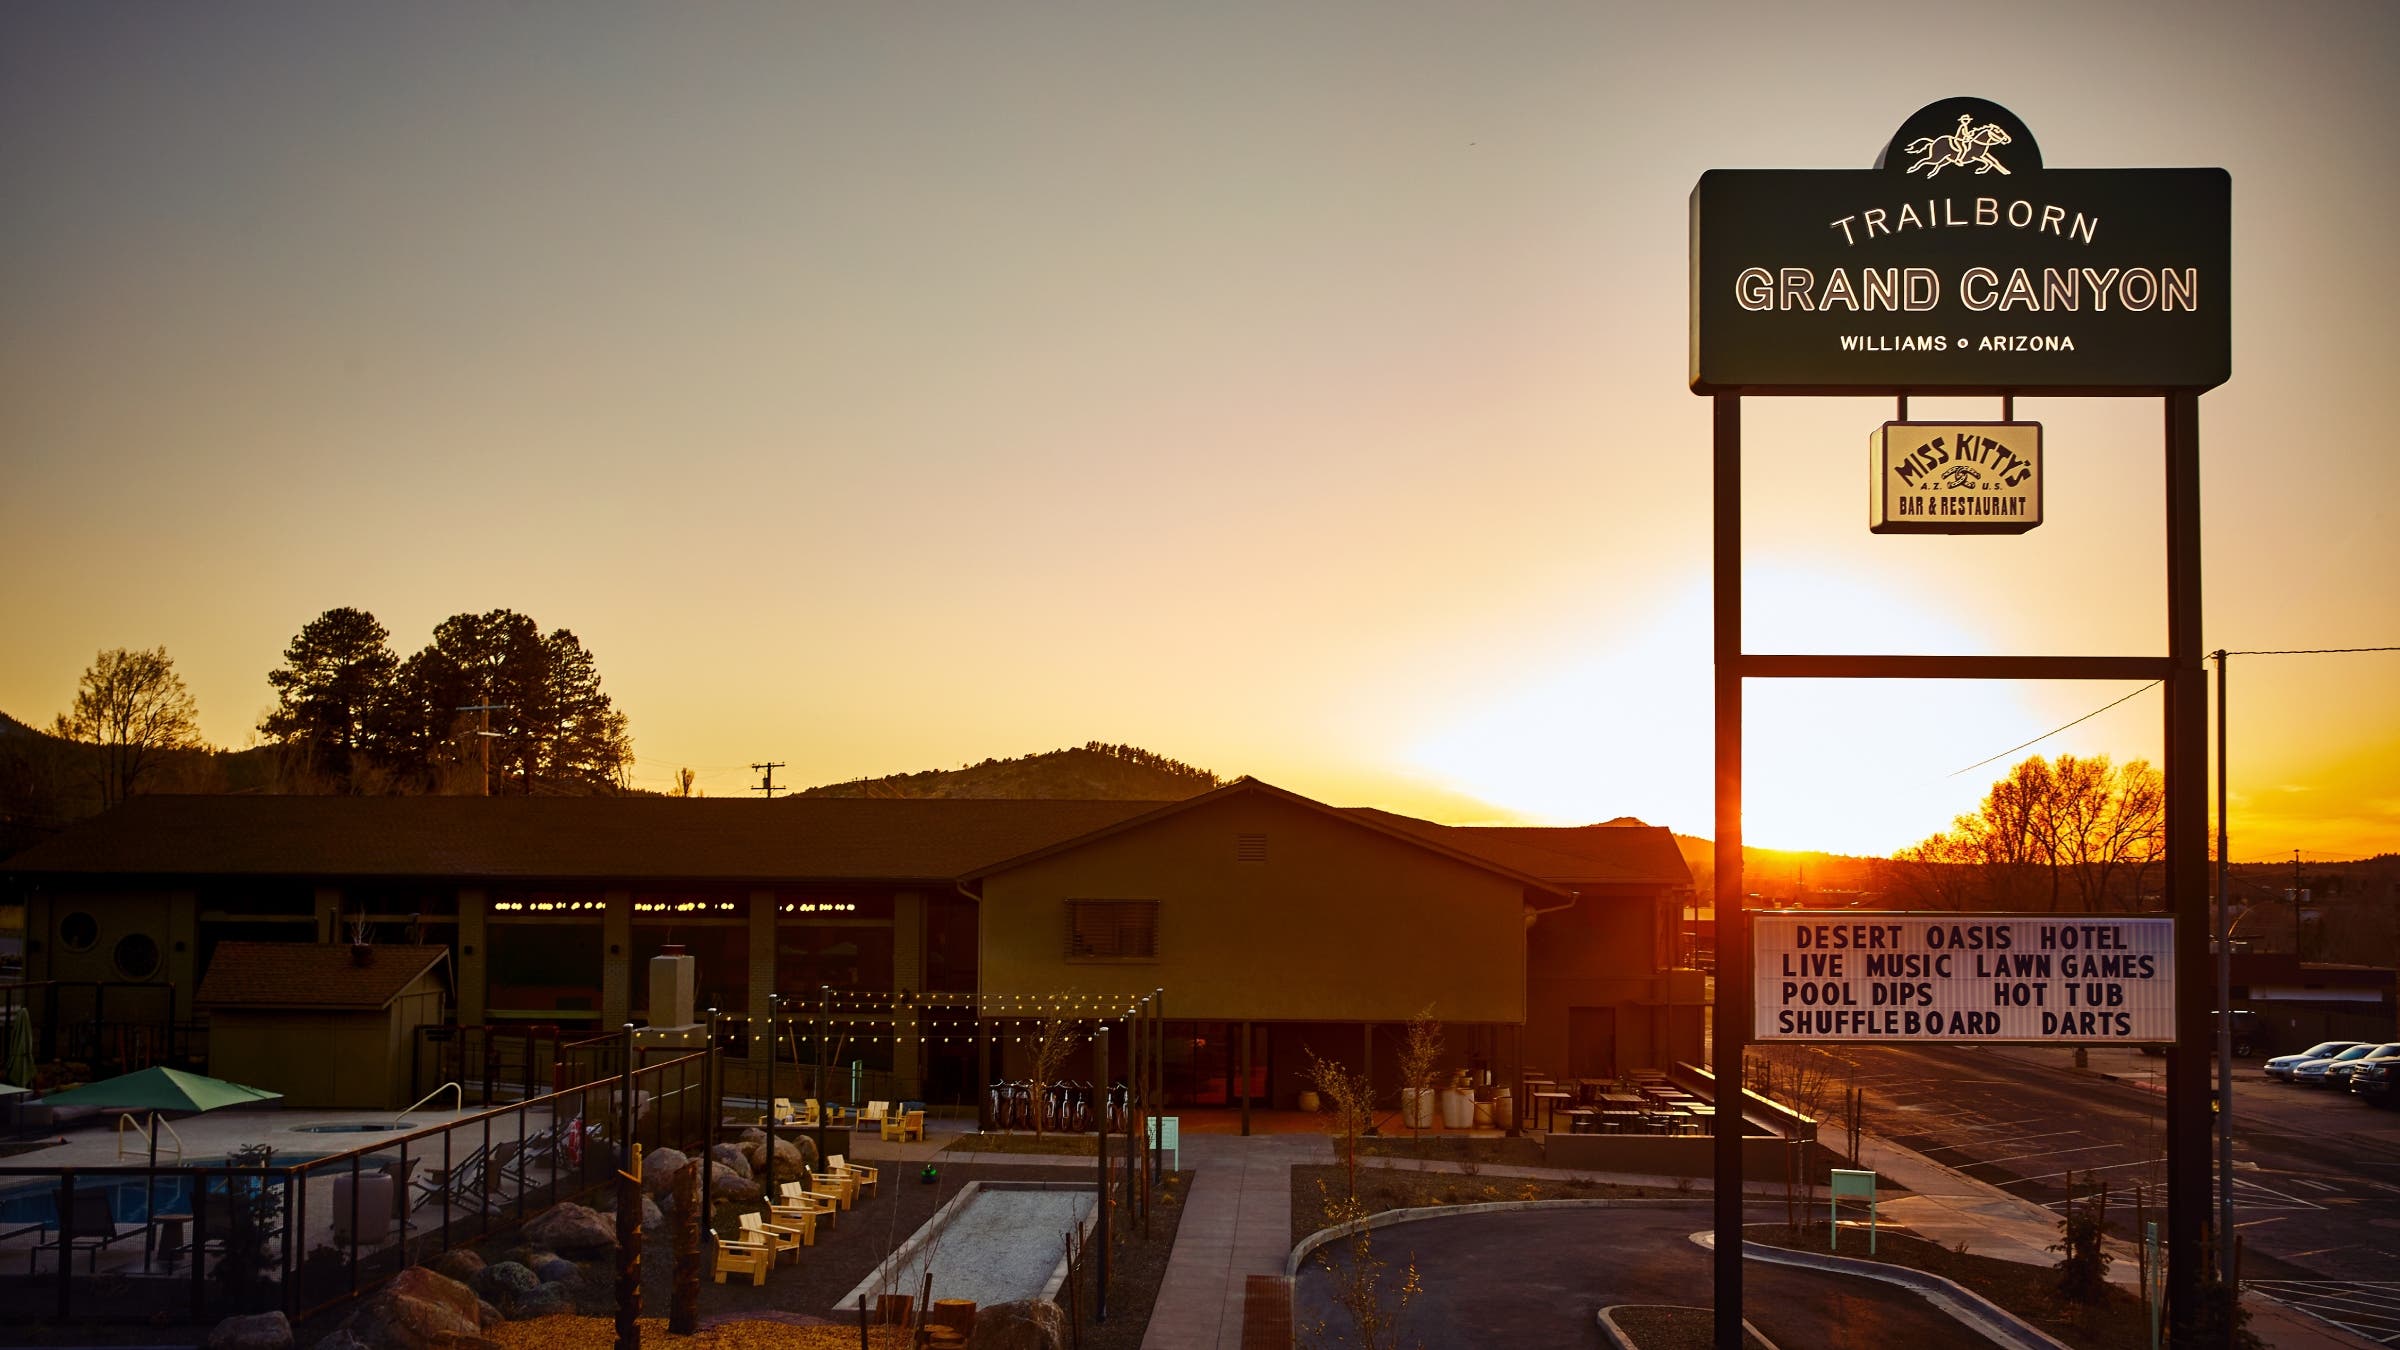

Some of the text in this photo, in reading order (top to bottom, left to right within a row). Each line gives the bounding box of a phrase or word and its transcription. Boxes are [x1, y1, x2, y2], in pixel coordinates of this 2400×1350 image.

[1831, 197, 2098, 246] TRAILBORN
[1736, 267, 2198, 313] GRAND CANYON
[1840, 335, 2075, 352] WILLIAMS ARIZONA
[1894, 433, 2031, 487] MISS KITTY'S
[1899, 496, 2026, 516] BAR & RESTAURANT
[1797, 925, 2128, 950] DESERT OASIS HOTEL
[1782, 953, 2155, 979] LIVE MUSIC LAWN GAMES
[1782, 982, 2124, 1007] POOL DIPS HOT TUB
[1779, 1010, 2131, 1036] SHUFFLEBOARD DARTS
